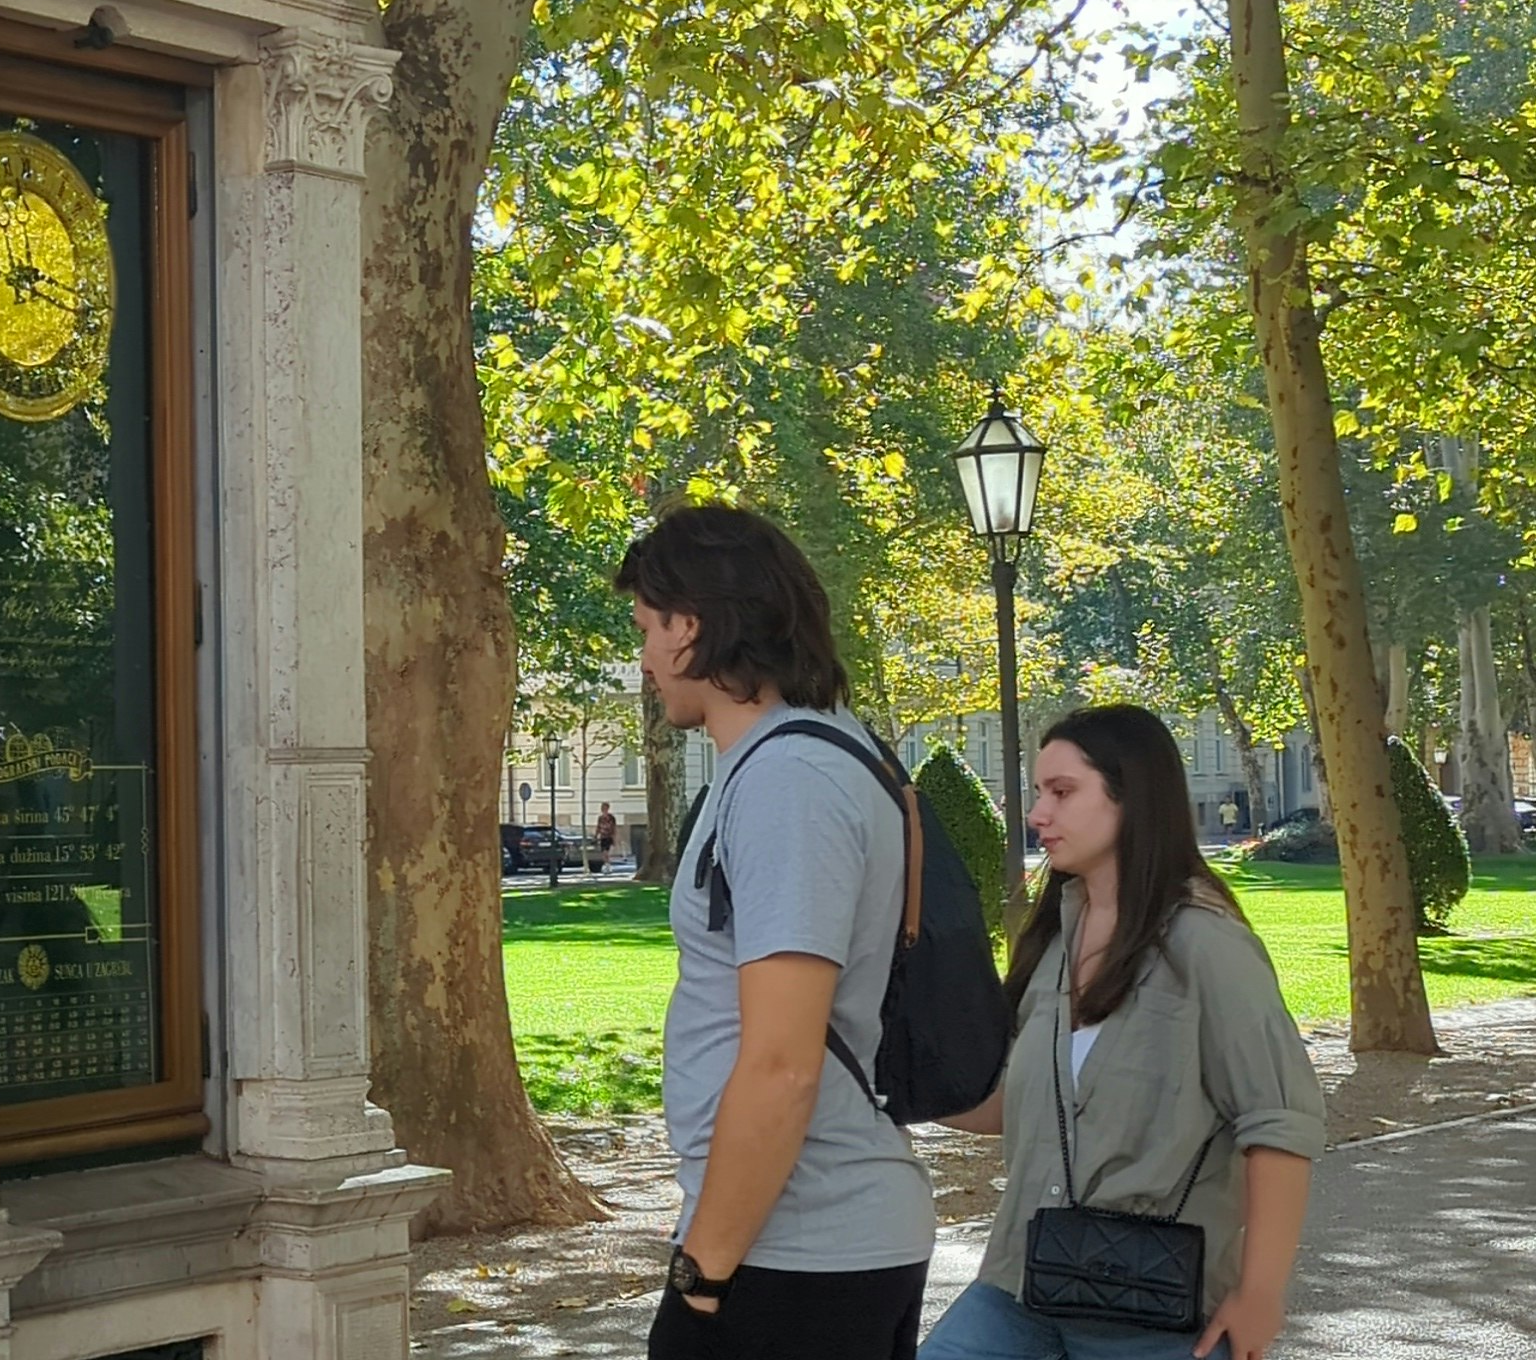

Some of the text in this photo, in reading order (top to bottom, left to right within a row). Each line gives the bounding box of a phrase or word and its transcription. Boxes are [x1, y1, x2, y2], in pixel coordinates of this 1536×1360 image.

[44, 751, 77, 768] PODACI
[14, 807, 49, 825] širina
[10, 845, 52, 864] dužina
[5, 886, 43, 904] visina
